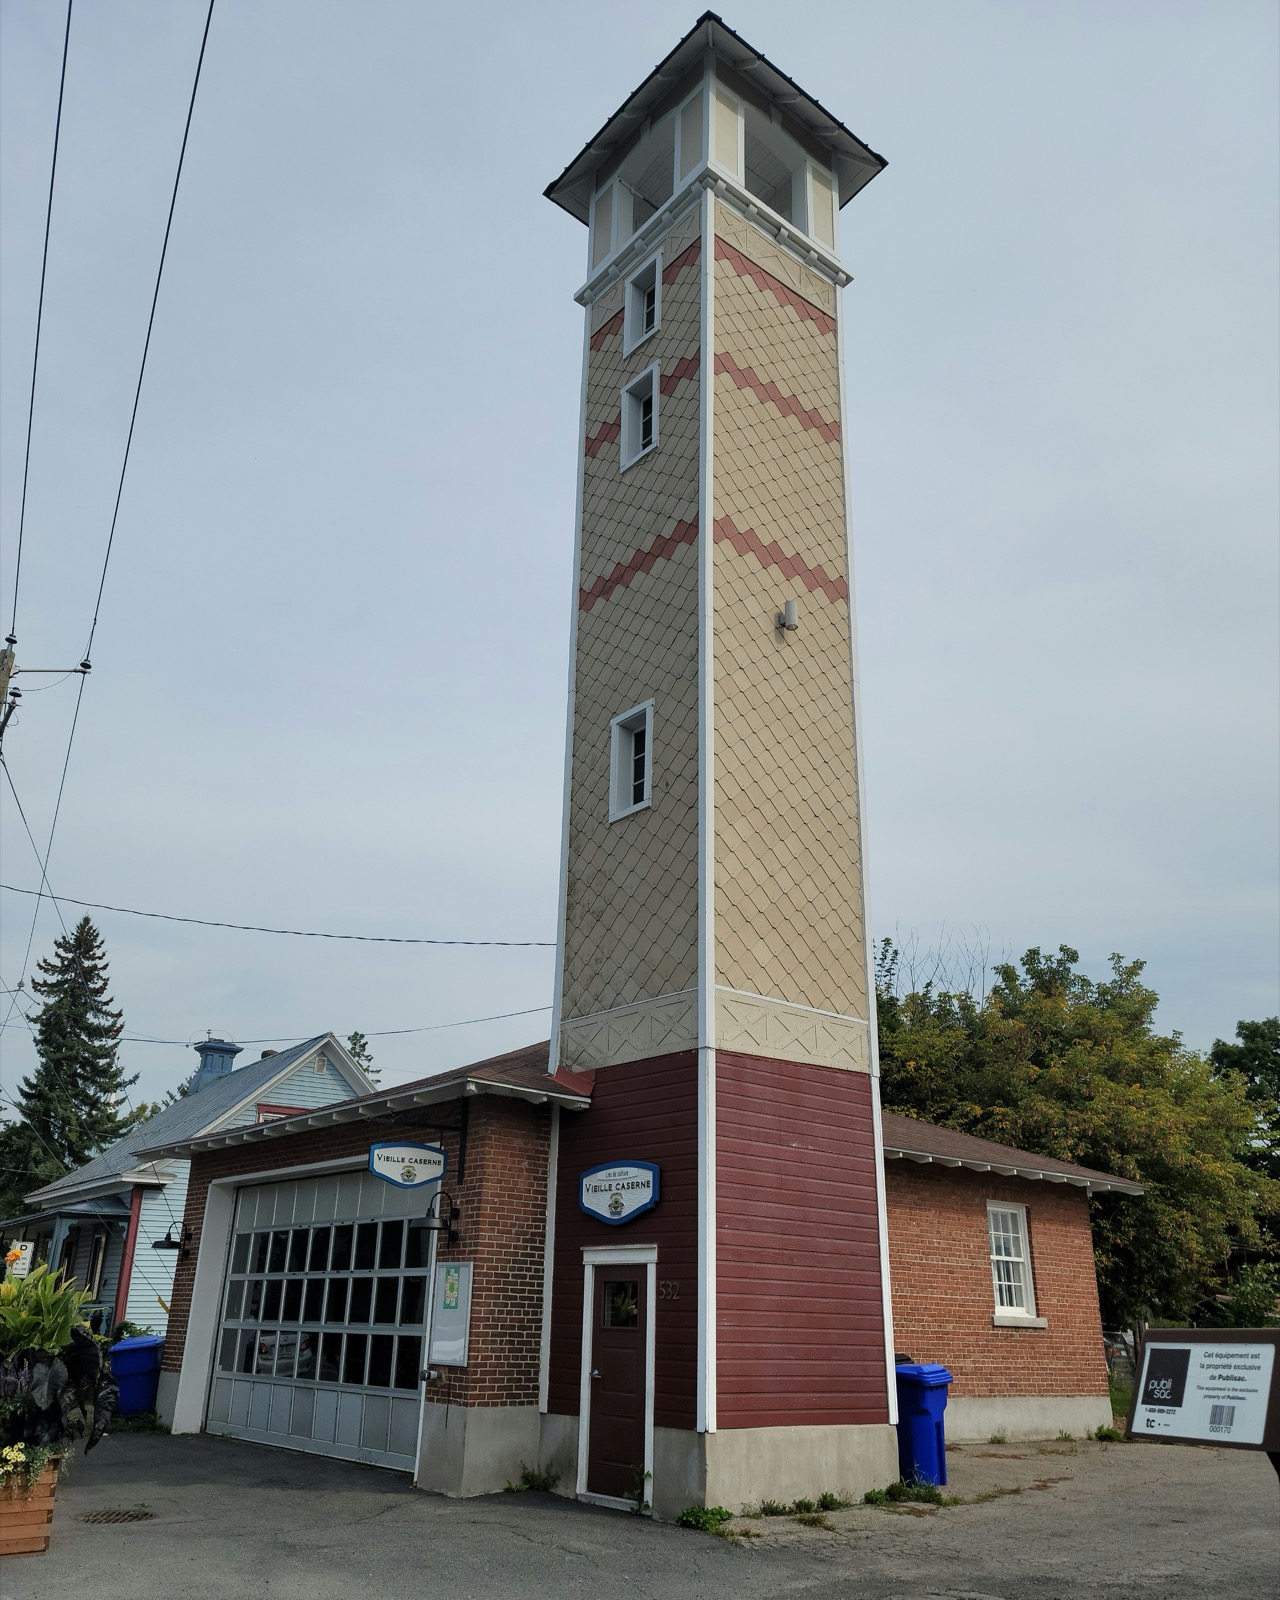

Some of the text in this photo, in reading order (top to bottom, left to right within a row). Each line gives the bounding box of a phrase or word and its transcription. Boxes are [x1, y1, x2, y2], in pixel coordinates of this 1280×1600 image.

[376, 1153, 442, 1166] VIEILLE CASERNE
[585, 1180, 651, 1193] VIEILLE CASERNE
[659, 1281, 680, 1300] 532
[1203, 1351, 1214, 1359] Cet
[1215, 1351, 1250, 1360] équipement
[1233, 1363, 1261, 1371] exclusive
[1217, 1374, 1247, 1382] Publisac.
[1148, 1378, 1172, 1390] publi
[1153, 1390, 1171, 1398] sac
[1146, 1418, 1156, 1428] tc
[1209, 1425, 1231, 1433] 000170
